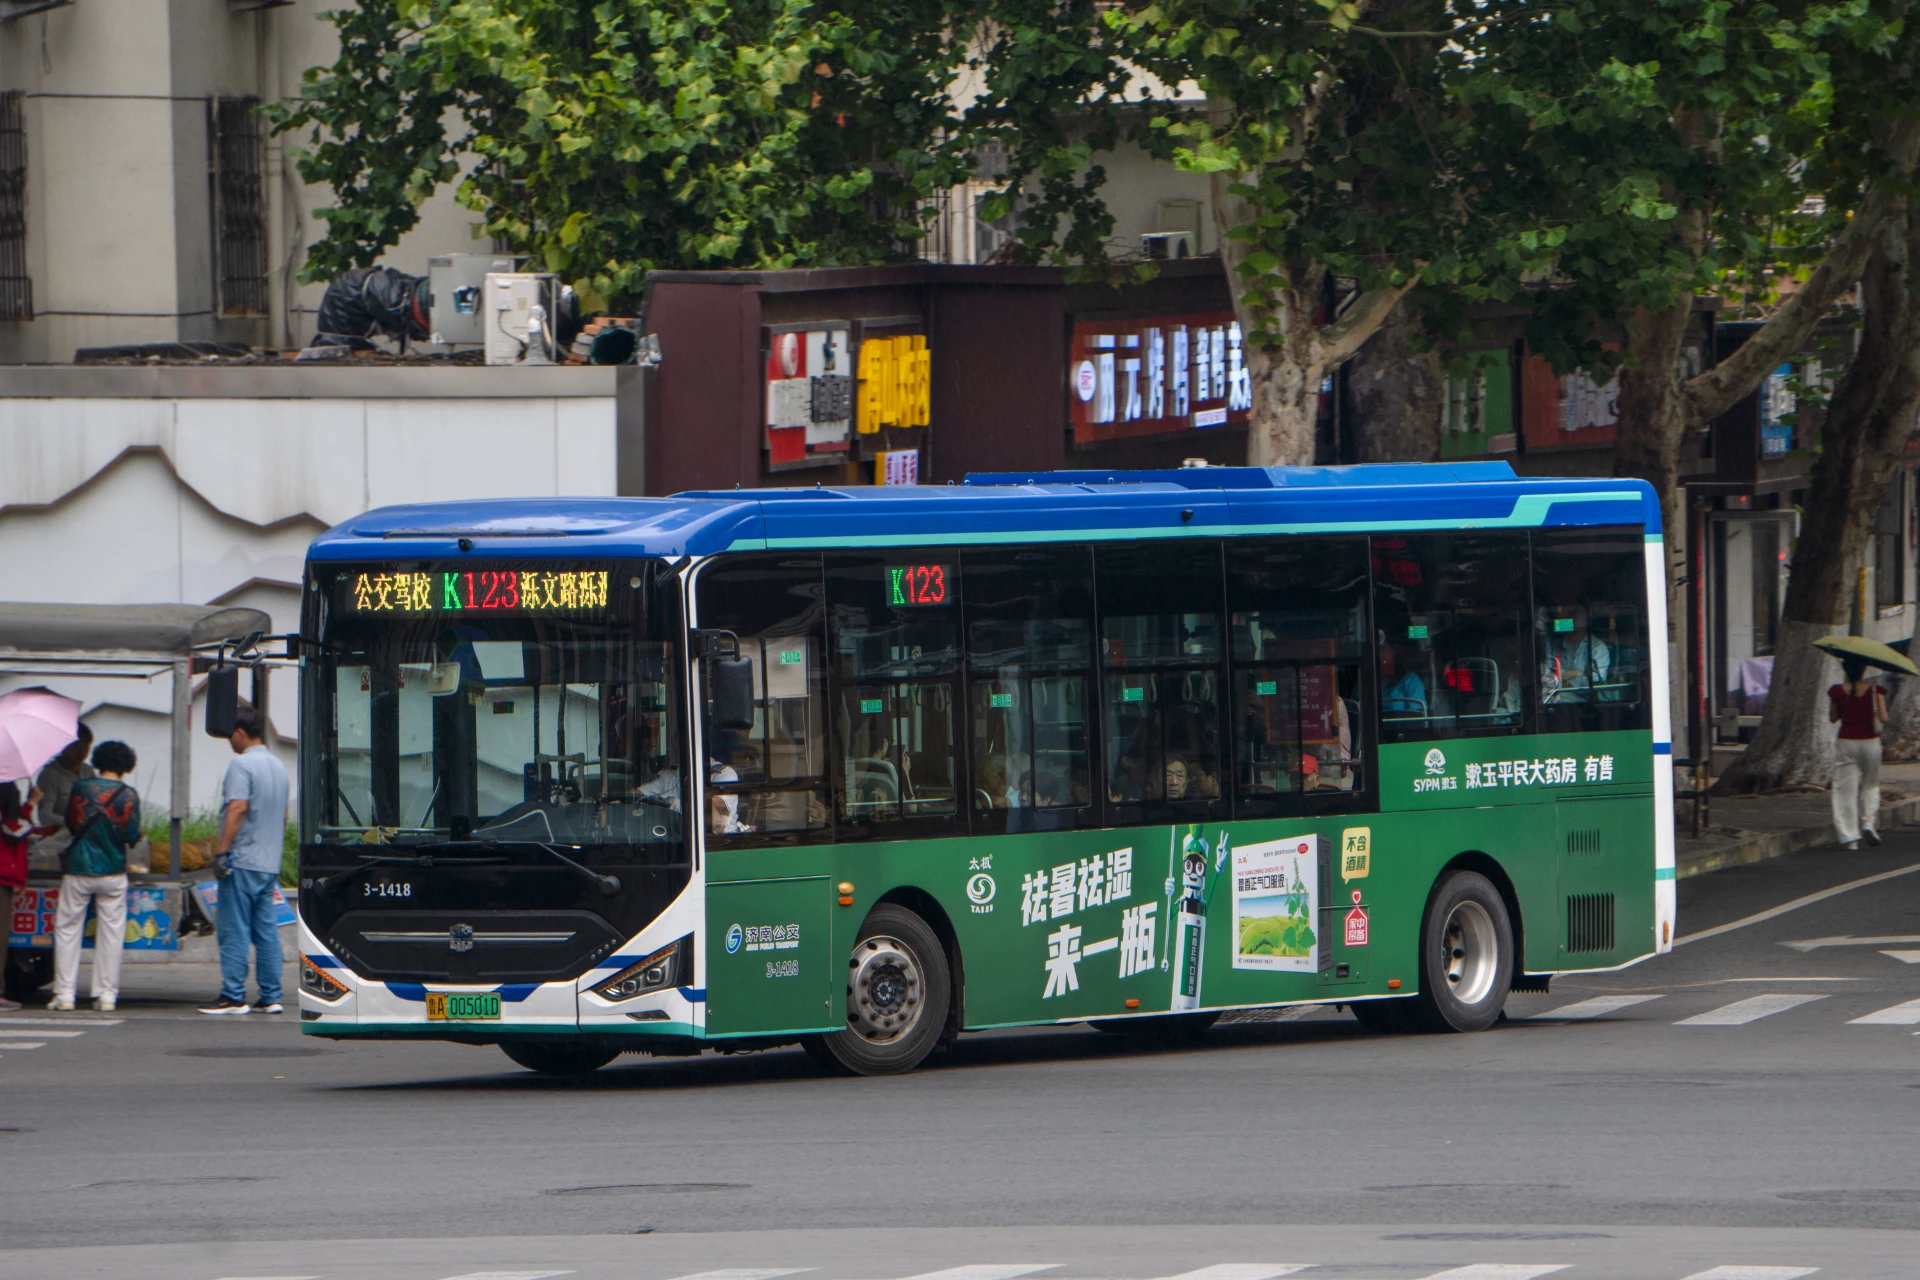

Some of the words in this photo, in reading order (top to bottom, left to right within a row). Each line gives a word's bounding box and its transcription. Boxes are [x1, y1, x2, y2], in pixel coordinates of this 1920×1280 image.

[354, 572, 432, 610] 公交驾校
[442, 571, 518, 610] K123
[891, 565, 945, 604] K123
[1465, 758, 1577, 789] 漱玉平民大药房
[1584, 755, 1614, 782] 有售
[1414, 778, 1440, 792] SYPM
[1346, 835, 1367, 852] 不含
[969, 855, 992, 871] 太极
[1345, 855, 1367, 872] 酒精
[363, 883, 411, 896] 3-1418
[1021, 847, 1132, 927] 祛暑祛湿
[971, 904, 993, 914] TAIJI
[745, 924, 799, 942] 济南公交
[1042, 901, 1158, 999] 来一瓶
[766, 960, 799, 978] 3-1418
